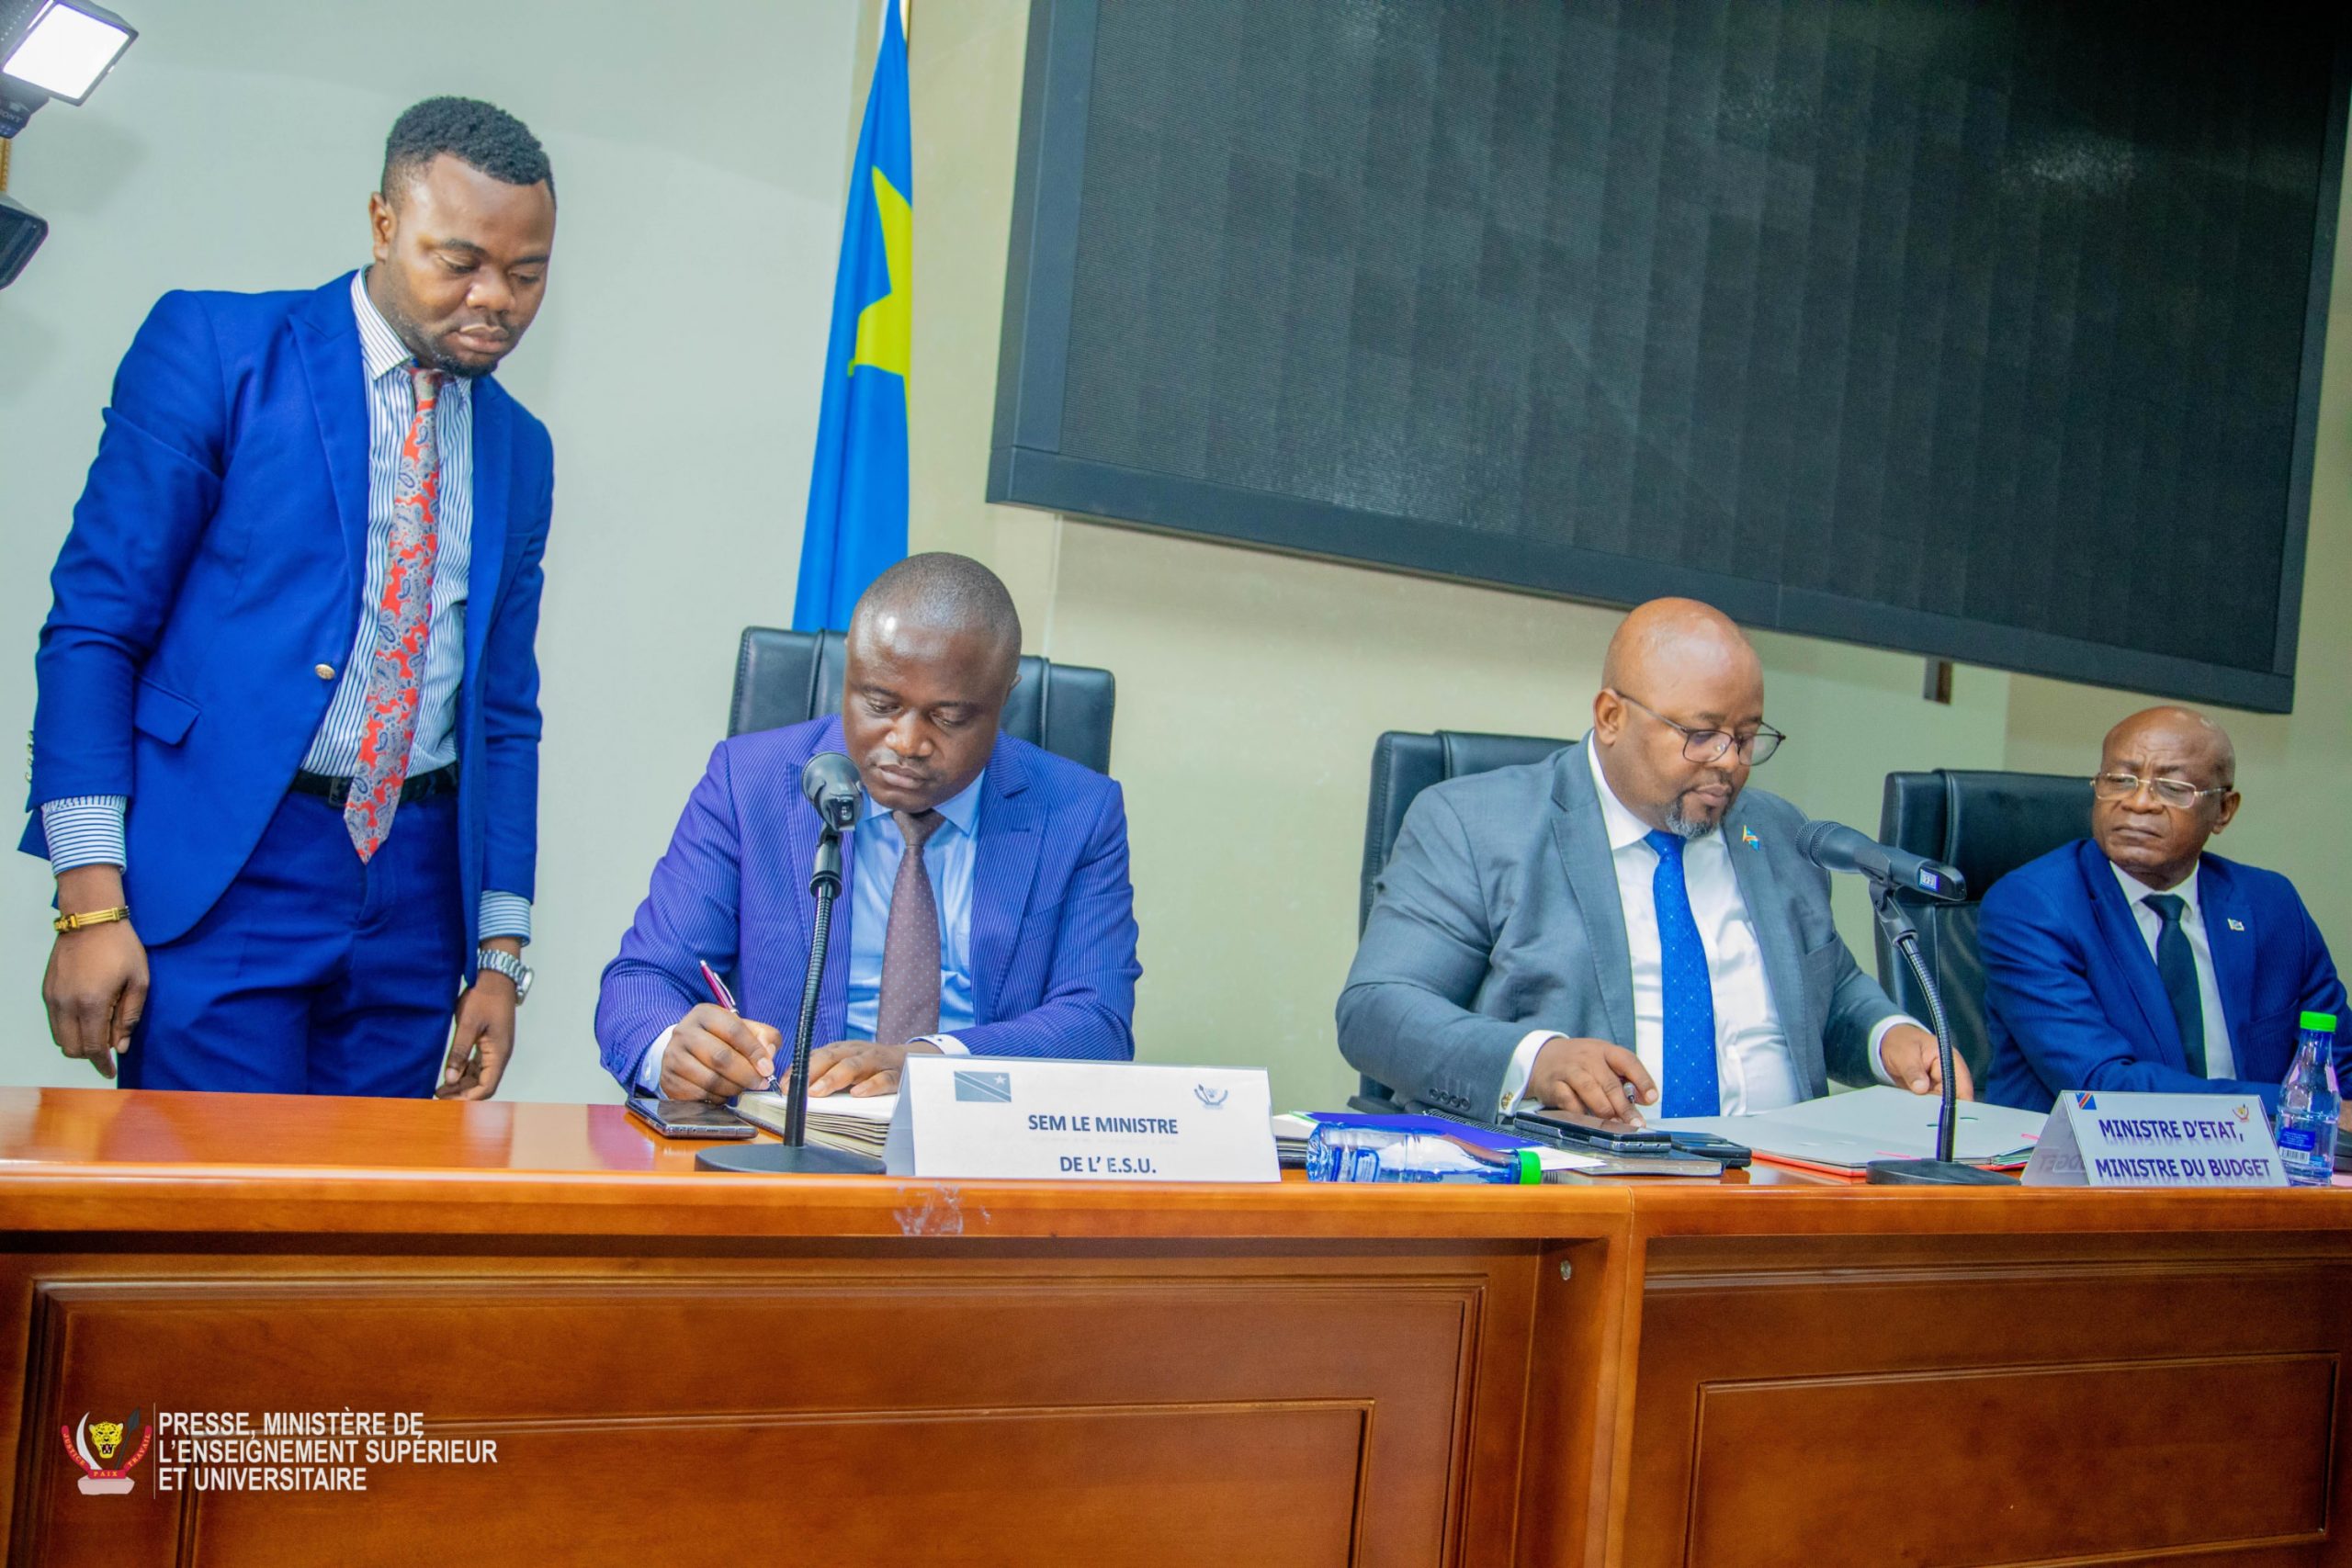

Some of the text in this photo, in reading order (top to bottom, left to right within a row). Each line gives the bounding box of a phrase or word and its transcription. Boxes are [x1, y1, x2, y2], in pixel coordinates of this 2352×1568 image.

[1028, 1114, 1179, 1134] SEM LE MINISTRE
[2098, 1119, 2244, 1142] MINISTRE D'ETAT,
[1059, 1156, 1083, 1172] DE
[1107, 1157, 1157, 1173] E.S.U.
[2095, 1158, 2271, 1178] MINISTRE DU BUDGET
